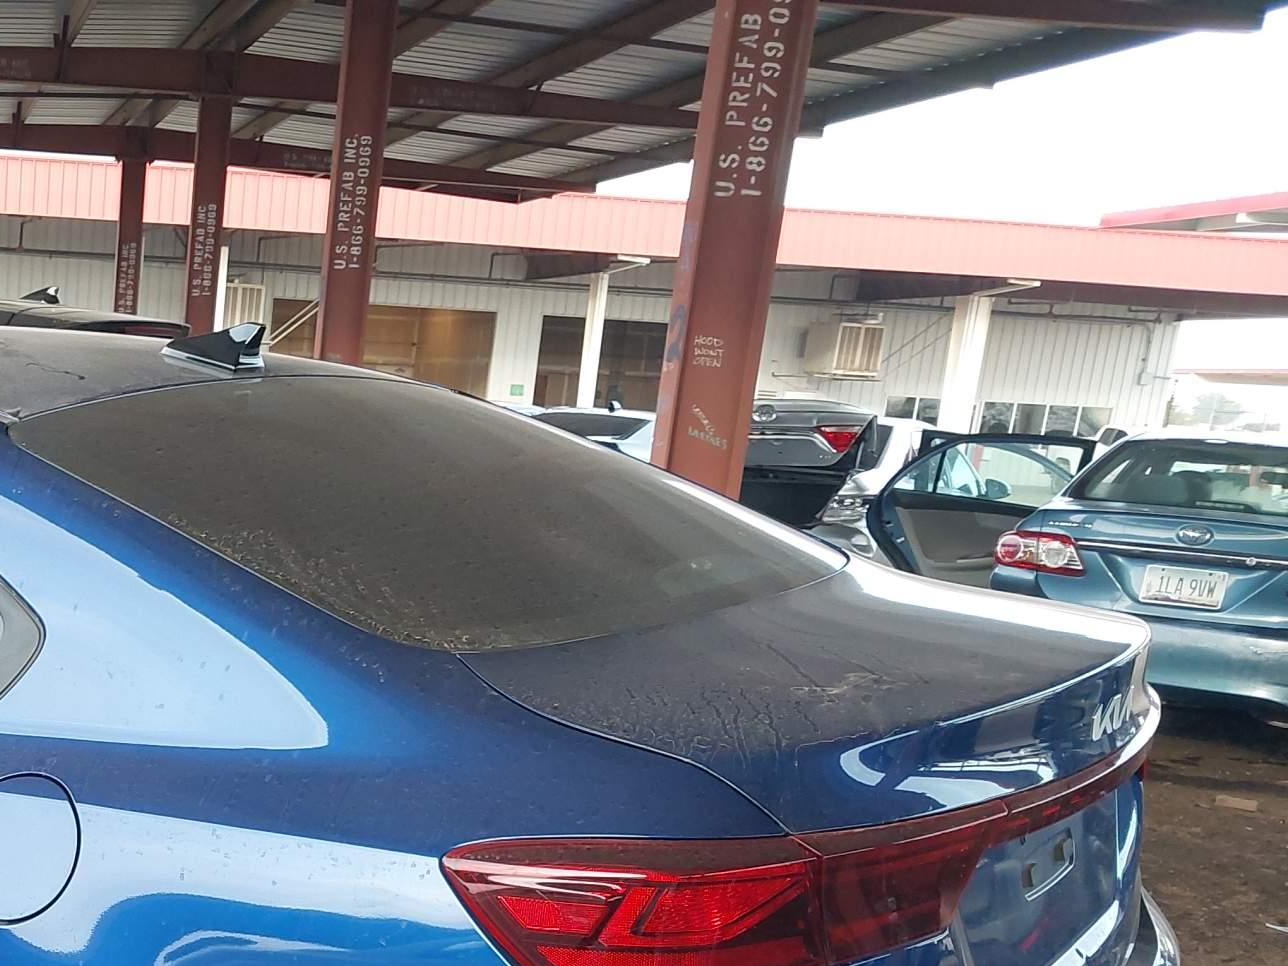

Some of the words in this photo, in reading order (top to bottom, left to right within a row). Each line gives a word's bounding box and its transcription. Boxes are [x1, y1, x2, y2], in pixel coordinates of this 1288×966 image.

[725, 13, 762, 126] PREFAB
[740, 0, 793, 197] 1-866-799-0
[337, 171, 354, 232] PREFAB
[348, 135, 373, 269] 1-866-799-0969
[714, 145, 743, 197] U.S.
[333, 241, 349, 270] U.S.
